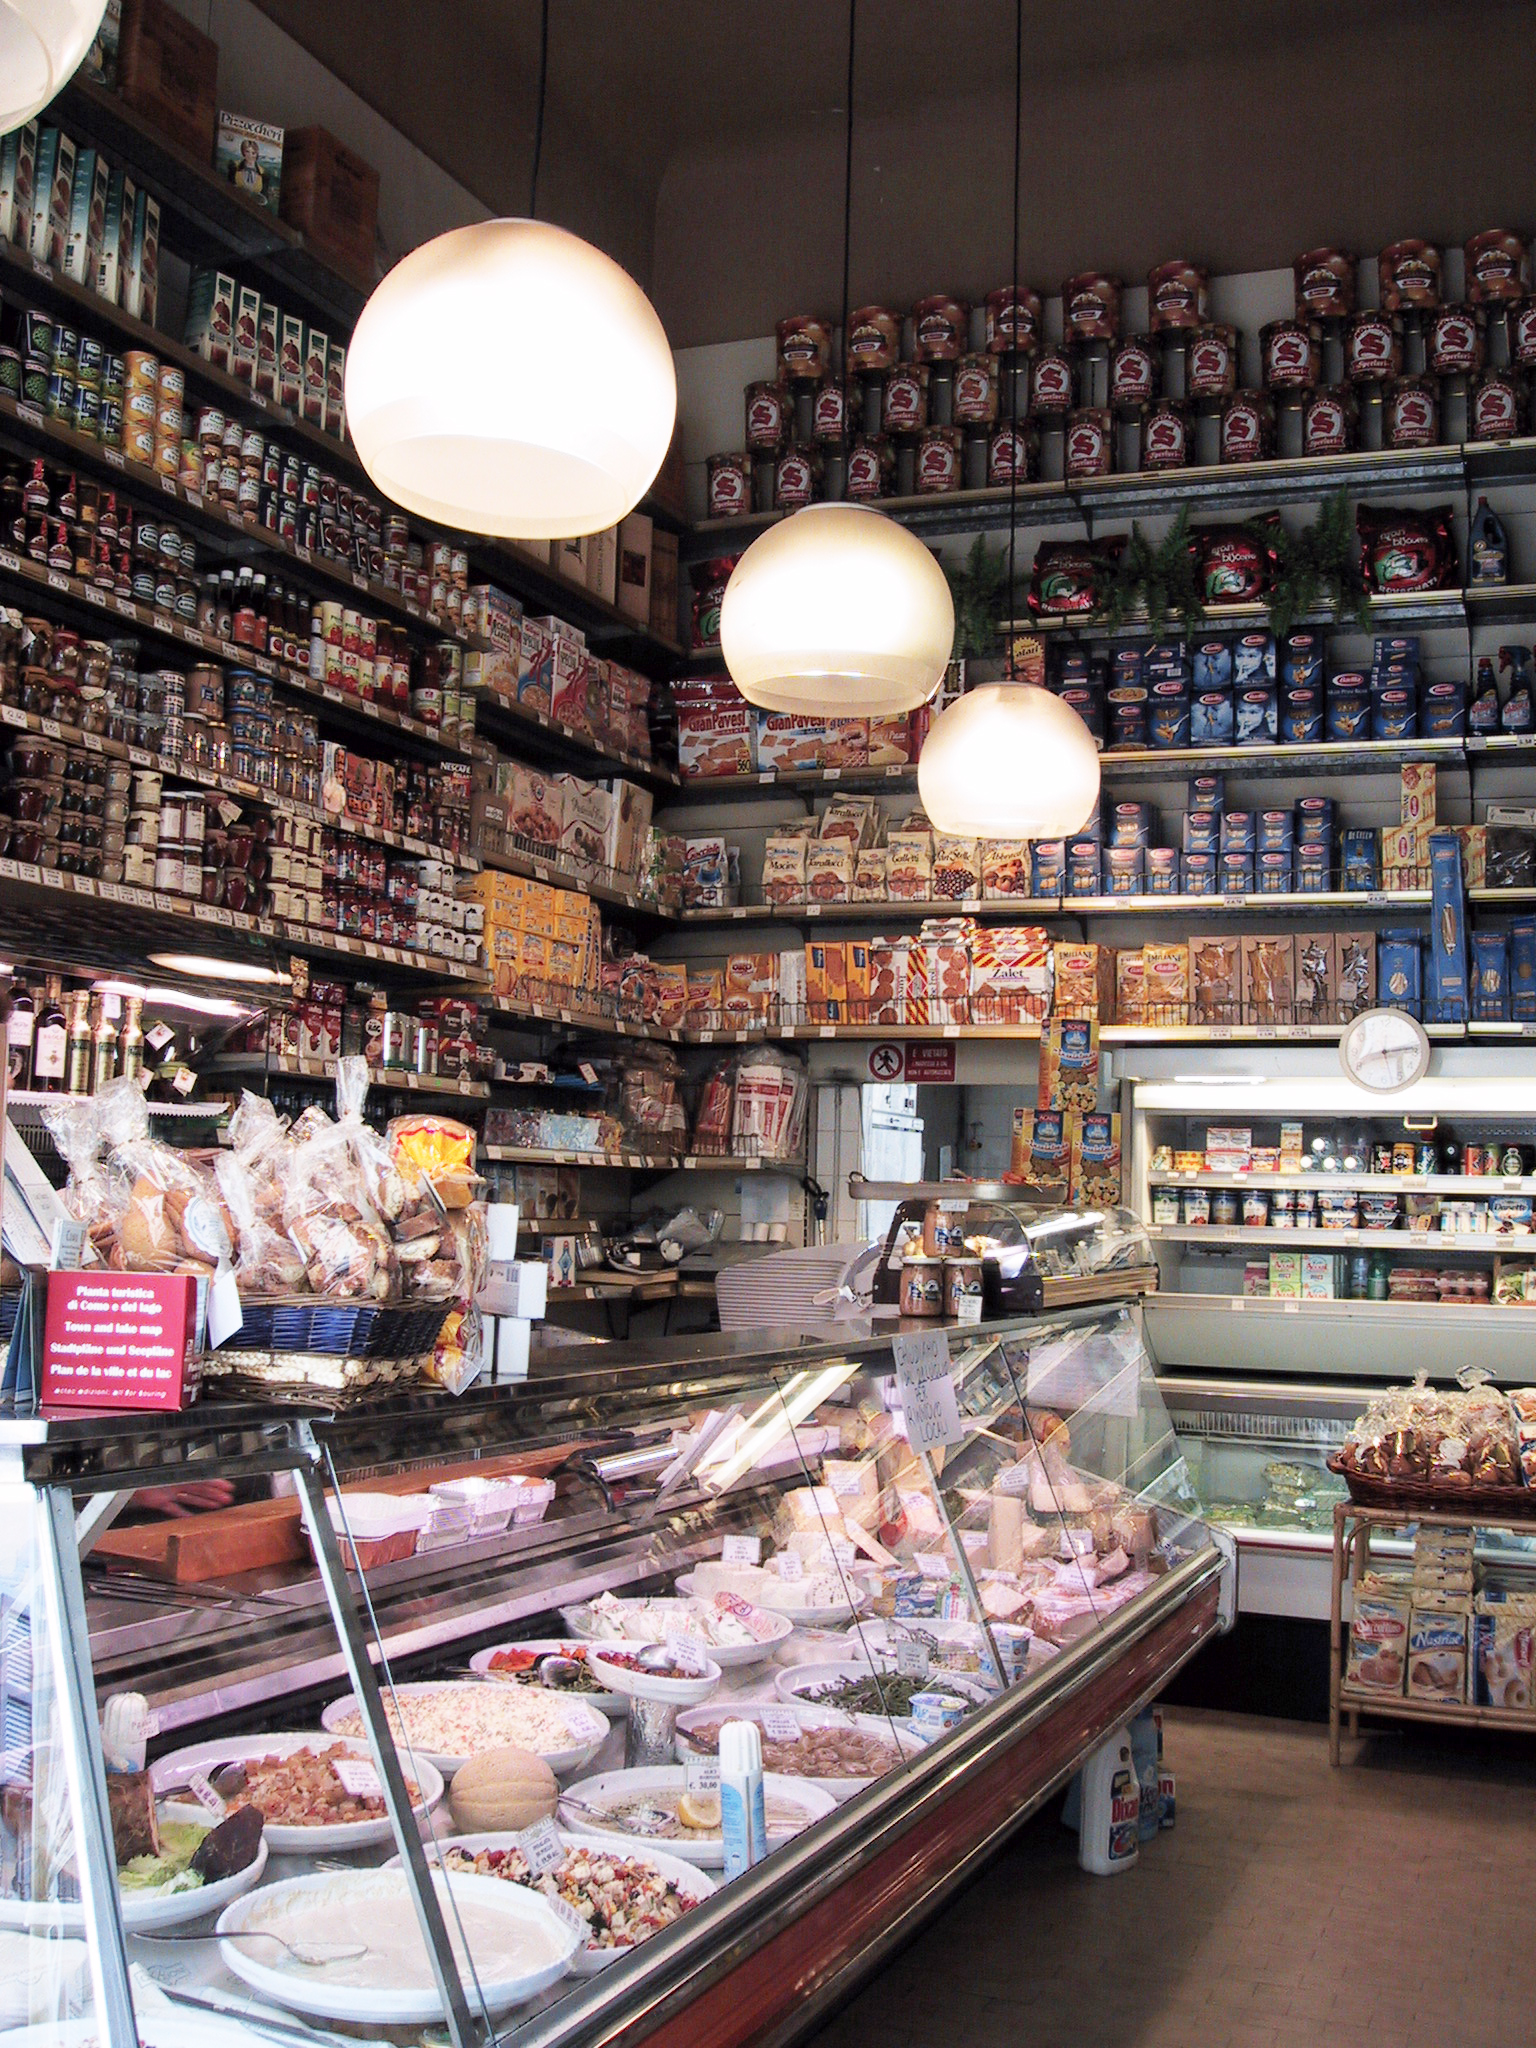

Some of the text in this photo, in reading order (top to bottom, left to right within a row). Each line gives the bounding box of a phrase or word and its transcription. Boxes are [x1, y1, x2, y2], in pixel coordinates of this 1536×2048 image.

[221, 111, 283, 142] Pizzoccheri
[689, 710, 746, 732] GranPavesi
[808, 857, 845, 868] Tarallucci
[992, 968, 1024, 979] Zalet
[76, 1286, 155, 1299] Pianta turistica
[67, 1300, 163, 1315] di Como e del lago
[64, 1321, 163, 1336] Town and lake map
[105, 1344, 127, 1356] und
[50, 1364, 173, 1379] Plan de la ville et du lac
[138, 1390, 167, 1399] touring
